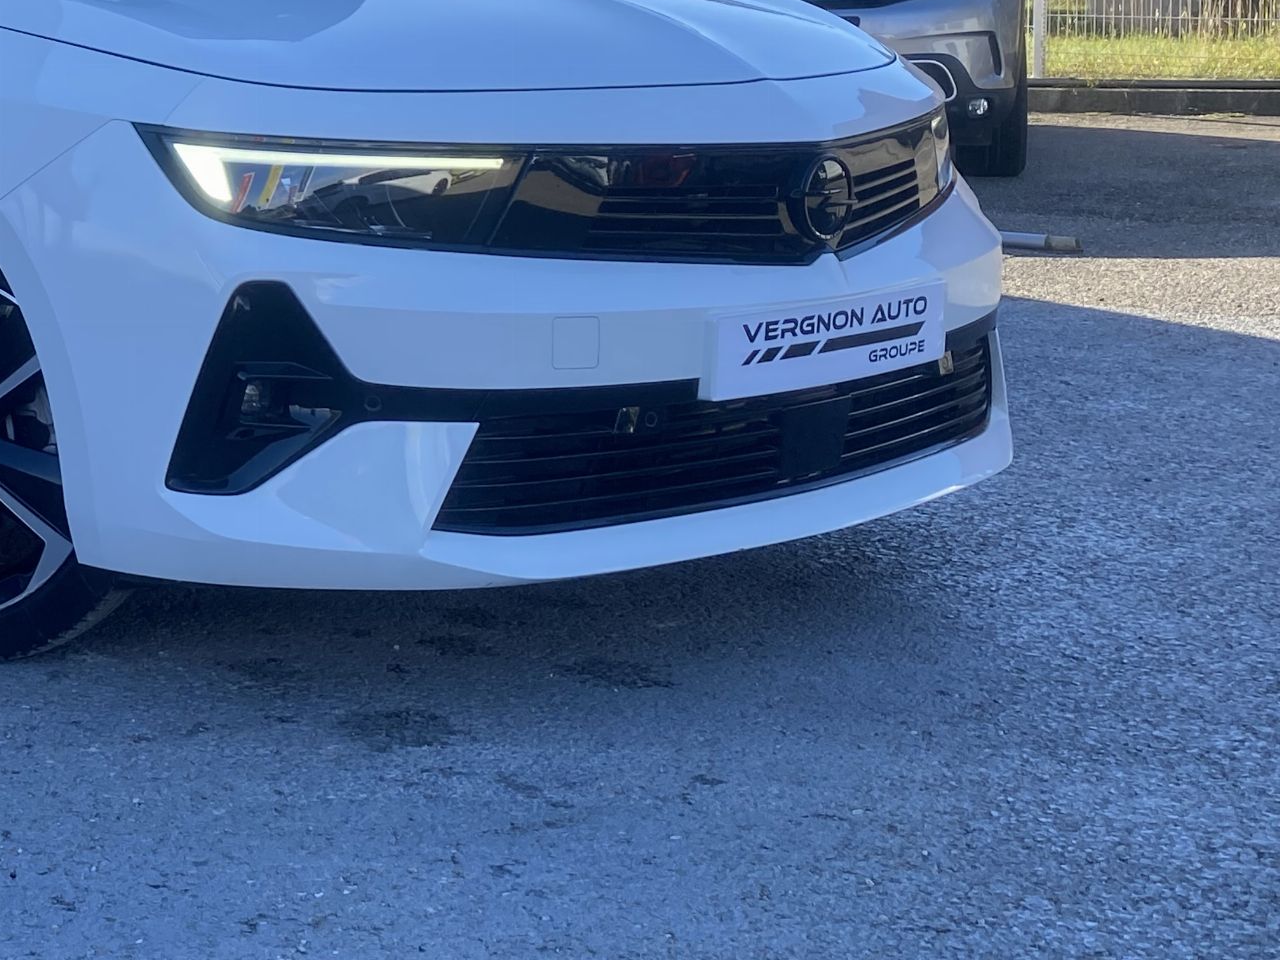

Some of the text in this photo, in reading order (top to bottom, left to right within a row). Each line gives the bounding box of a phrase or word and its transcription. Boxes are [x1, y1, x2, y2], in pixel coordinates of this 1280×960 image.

[741, 295, 929, 343] VERGNON AUTO
[868, 339, 926, 363] GROUPE
